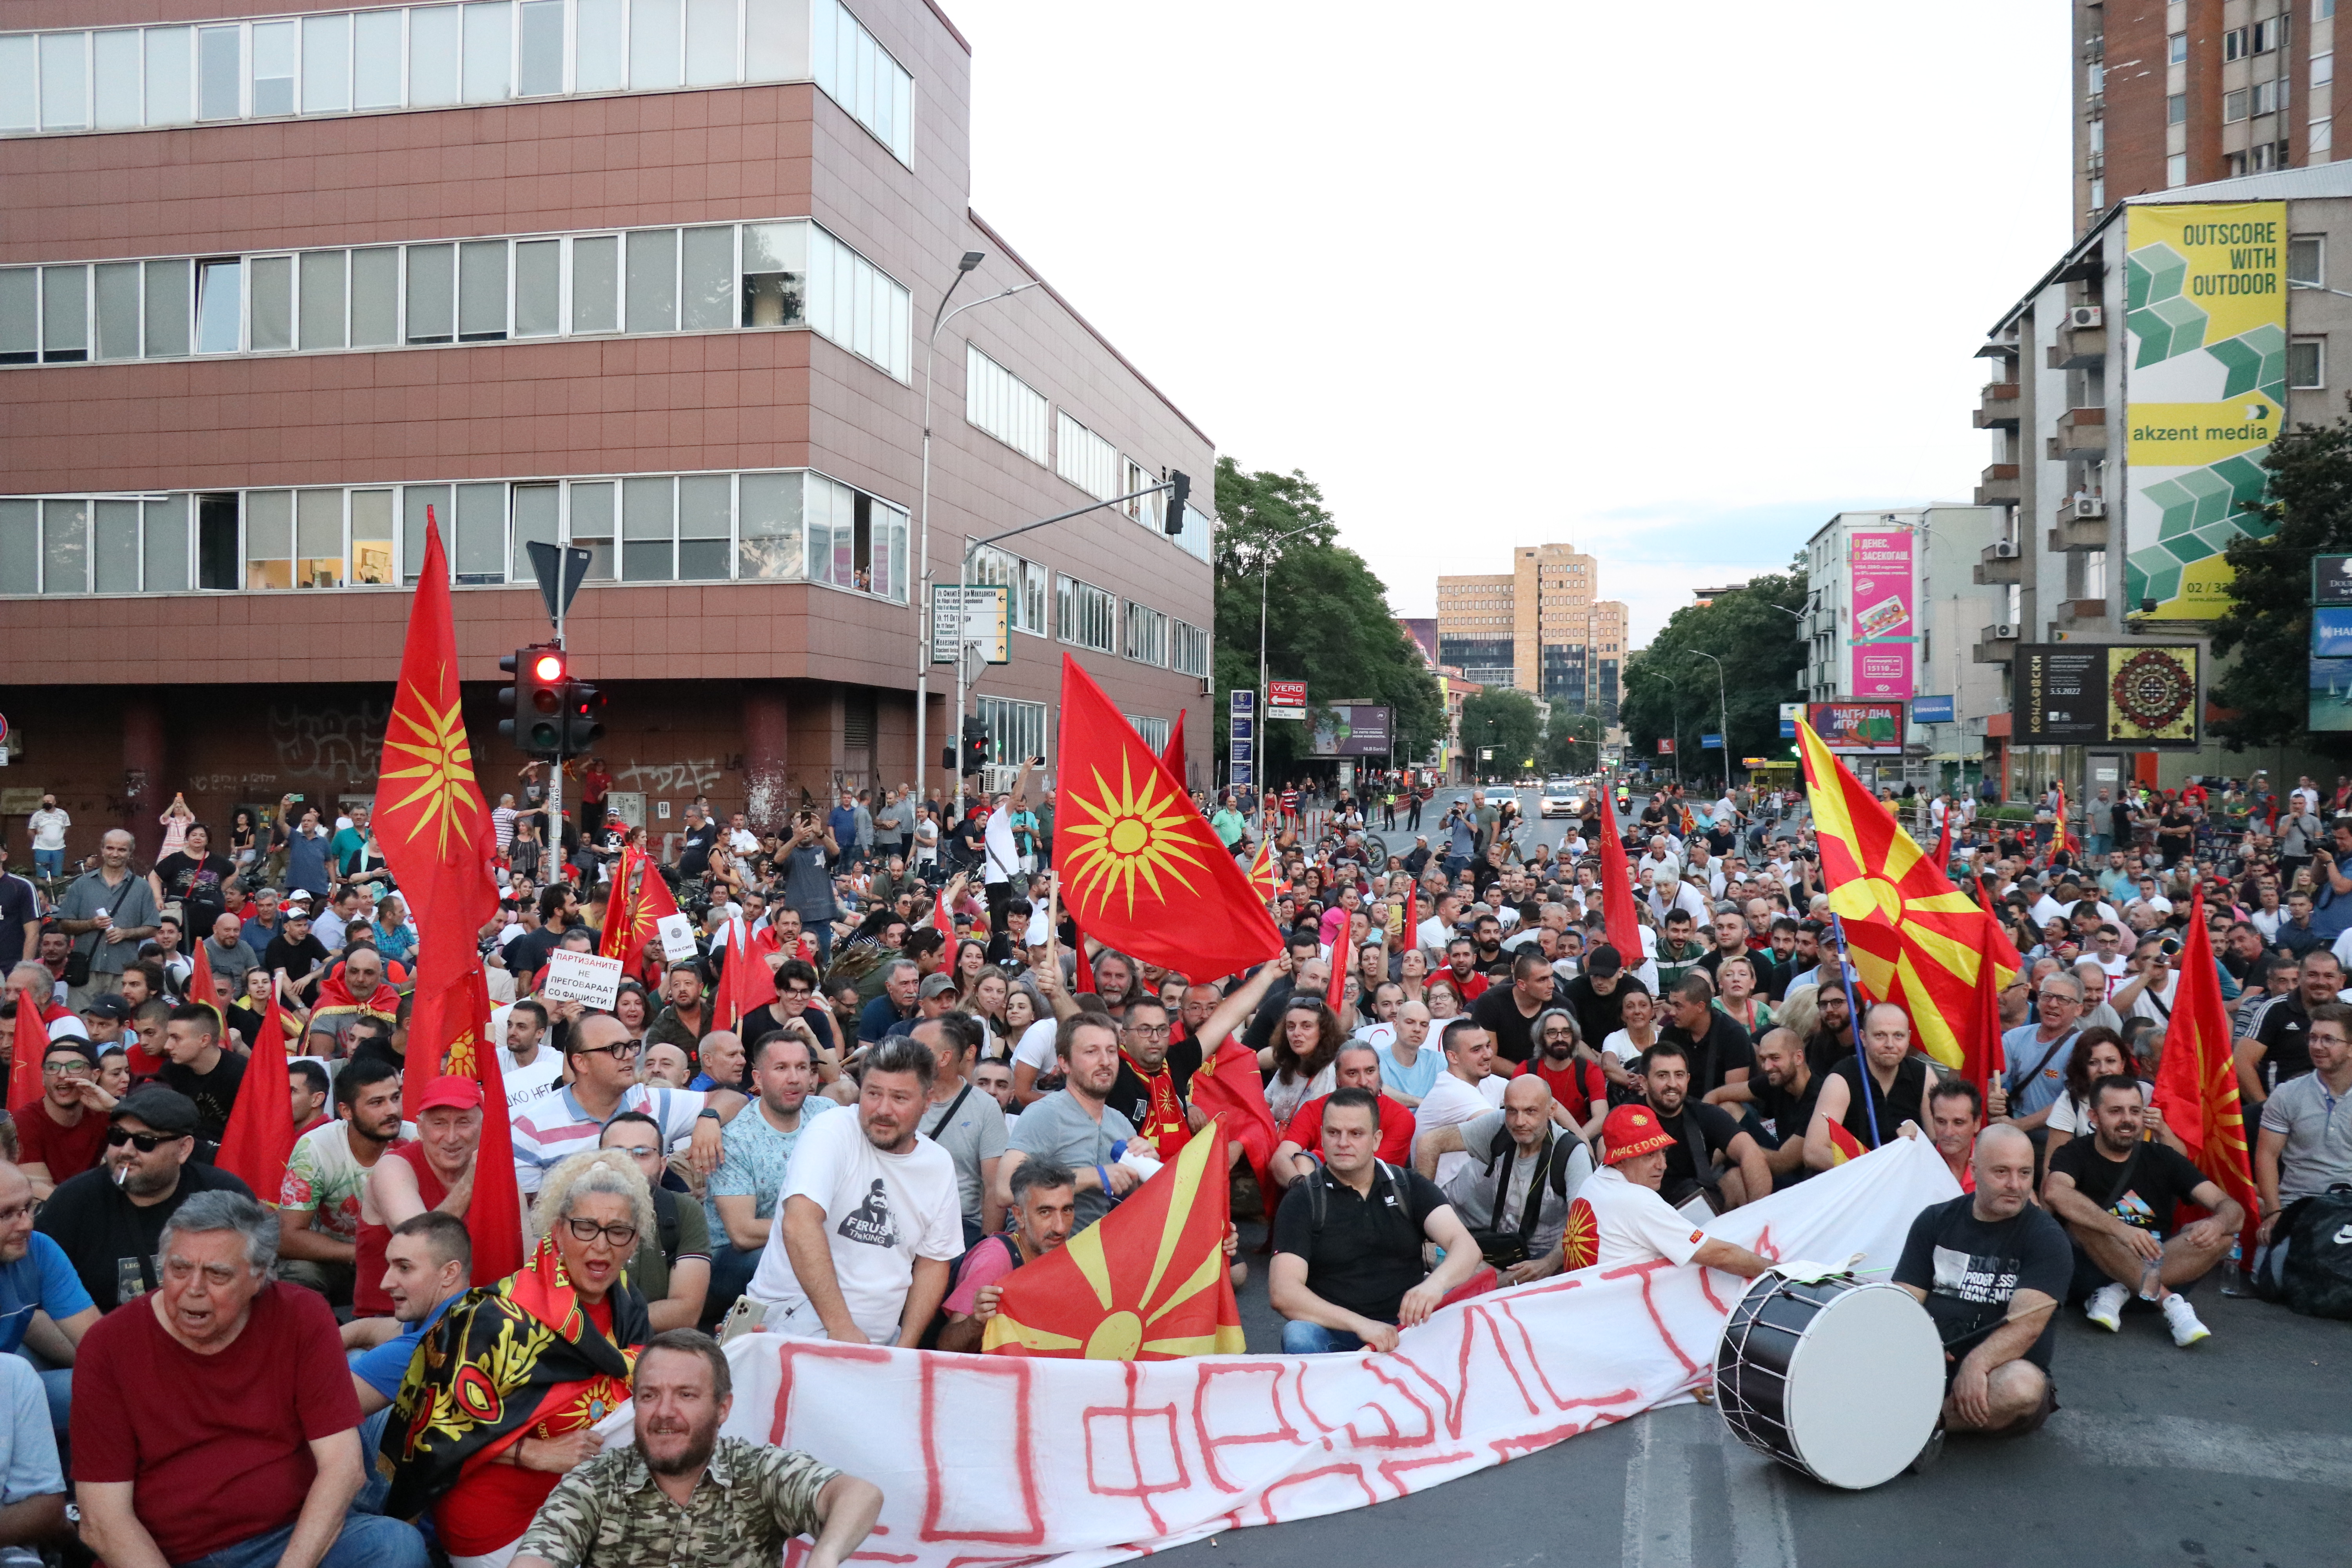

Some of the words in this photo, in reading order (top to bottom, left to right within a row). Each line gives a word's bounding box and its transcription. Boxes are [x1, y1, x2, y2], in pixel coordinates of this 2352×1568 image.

[2183, 222, 2277, 246] OUTSCORE
[2230, 247, 2276, 270] WITH
[2193, 273, 2277, 296] OUTDOOR
[2133, 425, 2199, 441] akzent
[2206, 423, 2269, 440] media
[2187, 583, 2202, 593] 02
[1833, 719, 1859, 730] ИГРА
[557, 953, 619, 971] ПАРТИЗАНИТЕ
[578, 969, 590, 978] НЕ
[551, 976, 614, 994] ПРЕГОВАРААТ
[548, 988, 561, 996] СО
[563, 991, 607, 1005] ФАШИСТИ
[846, 1216, 889, 1236] FERUS
[849, 1228, 862, 1239] The
[863, 1233, 885, 1244] KING
